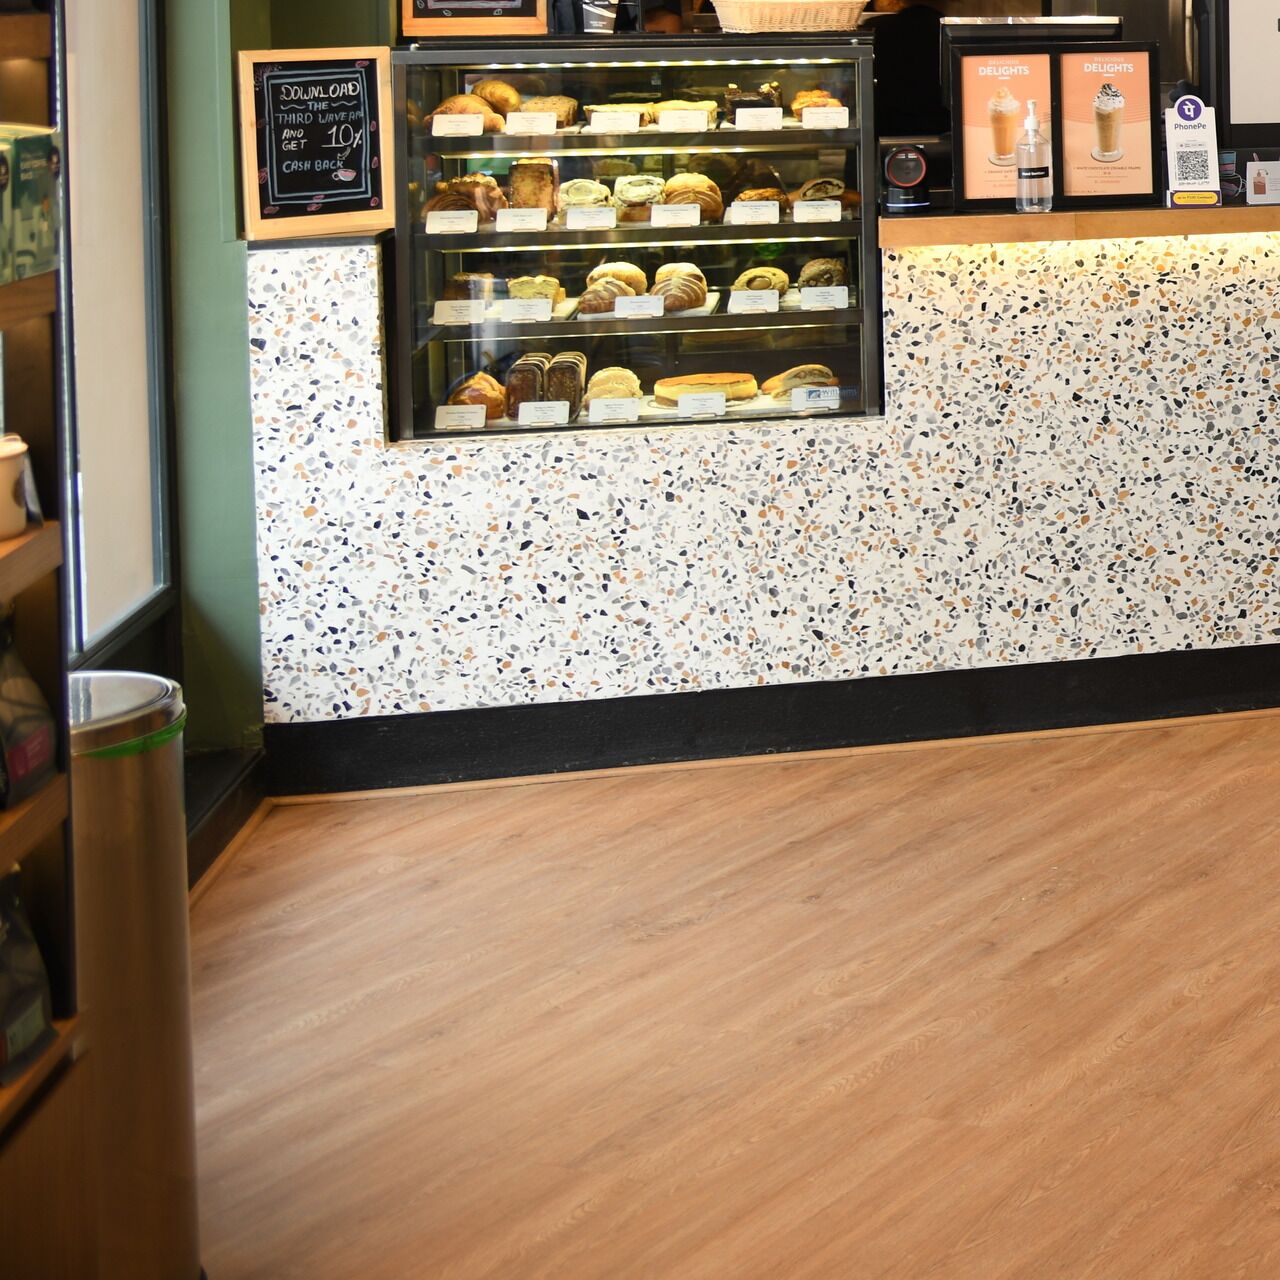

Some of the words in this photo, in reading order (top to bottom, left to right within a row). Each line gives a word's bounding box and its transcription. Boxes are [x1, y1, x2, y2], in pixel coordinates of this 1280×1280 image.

[978, 65, 1029, 75] DELIGHTS
[1084, 63, 1134, 72] DELIGHTS
[280, 81, 360, 101] DOWNLOAD
[307, 101, 329, 110] THE
[275, 113, 313, 124] THIRD
[318, 112, 349, 124] WAVE
[282, 128, 304, 140] AND
[321, 124, 363, 148] 10%
[282, 140, 308, 151] GET
[282, 161, 311, 173] CASH
[315, 160, 344, 171] BACK
